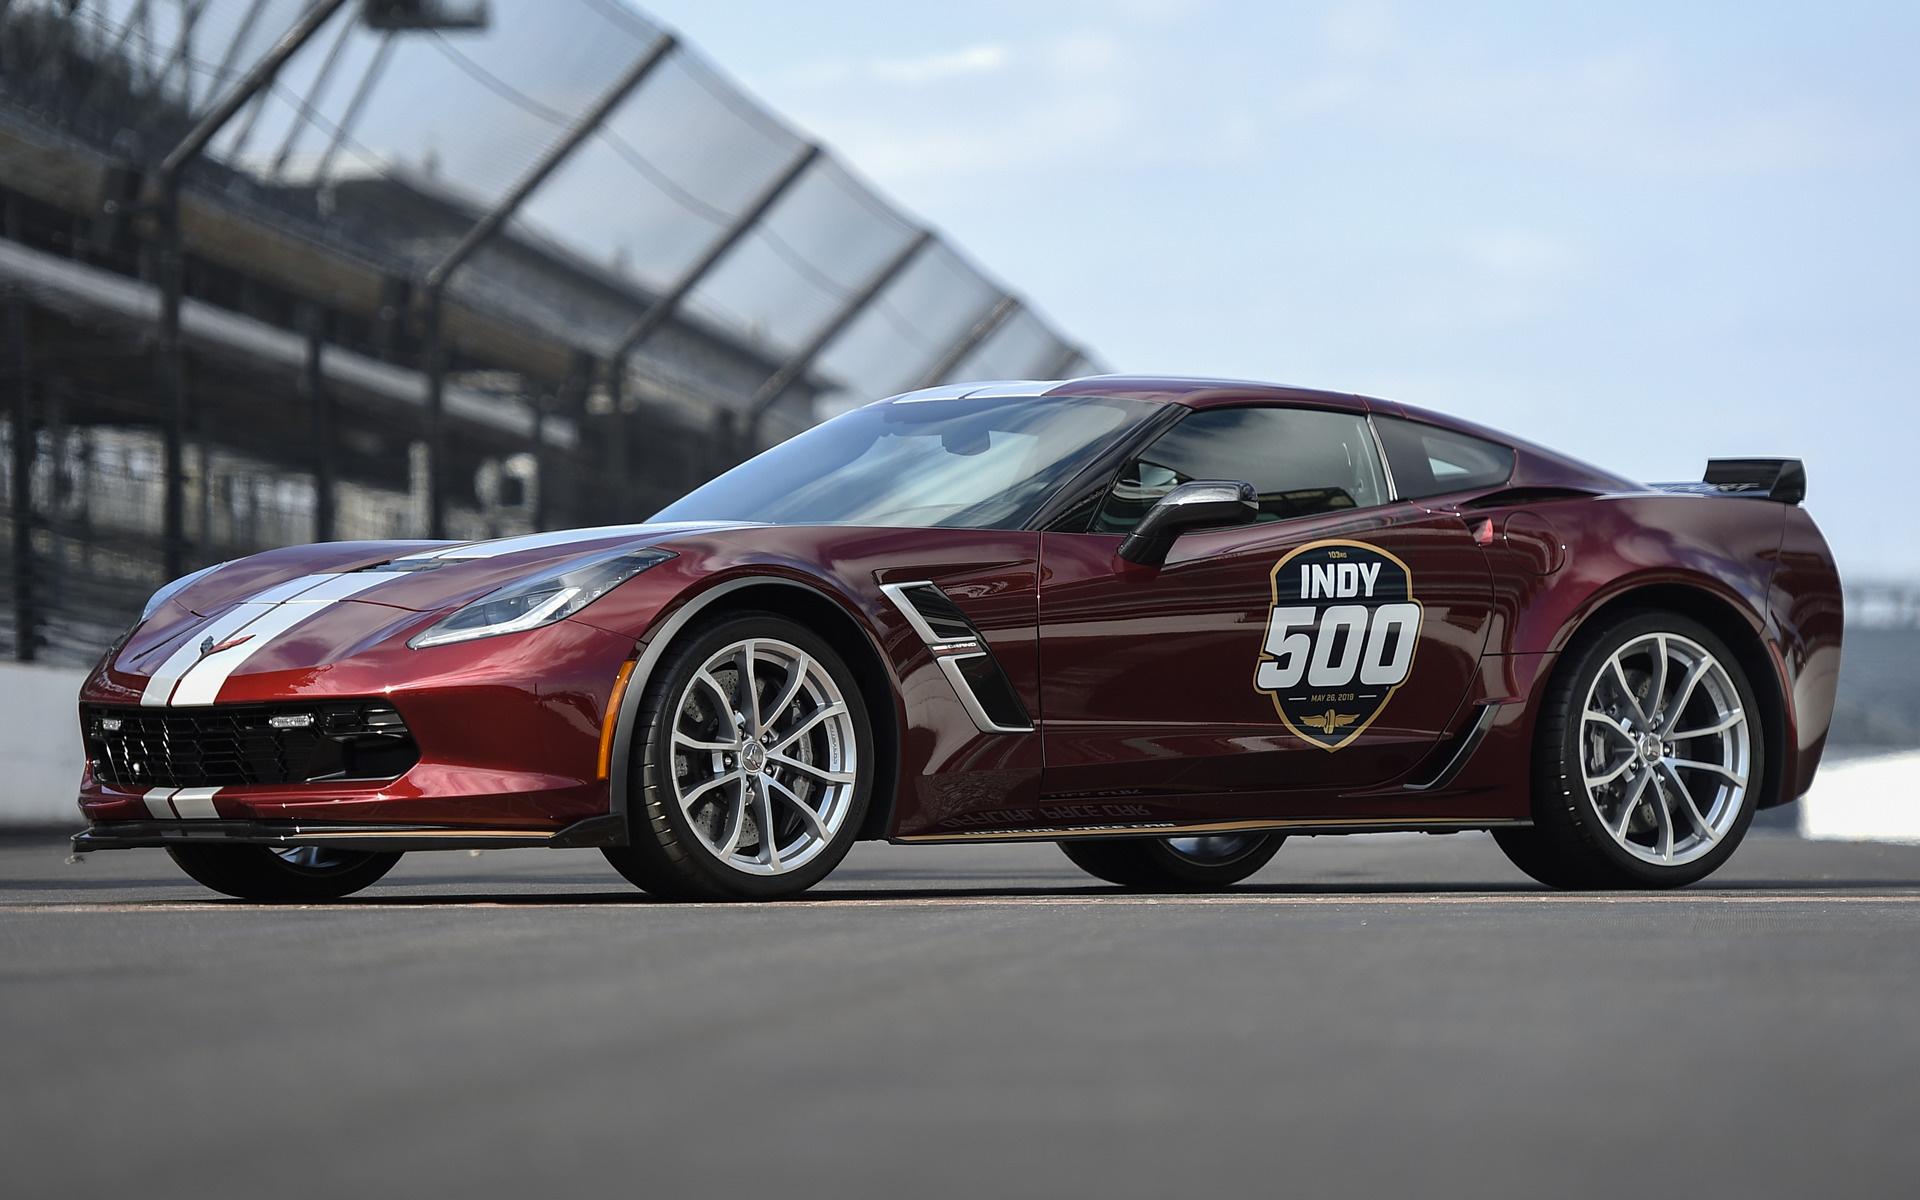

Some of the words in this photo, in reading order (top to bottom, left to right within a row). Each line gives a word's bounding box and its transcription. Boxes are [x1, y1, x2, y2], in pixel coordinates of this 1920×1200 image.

[1301, 562, 1381, 599] INDY
[1257, 603, 1420, 688] 500
[1310, 694, 1326, 702] MAY
